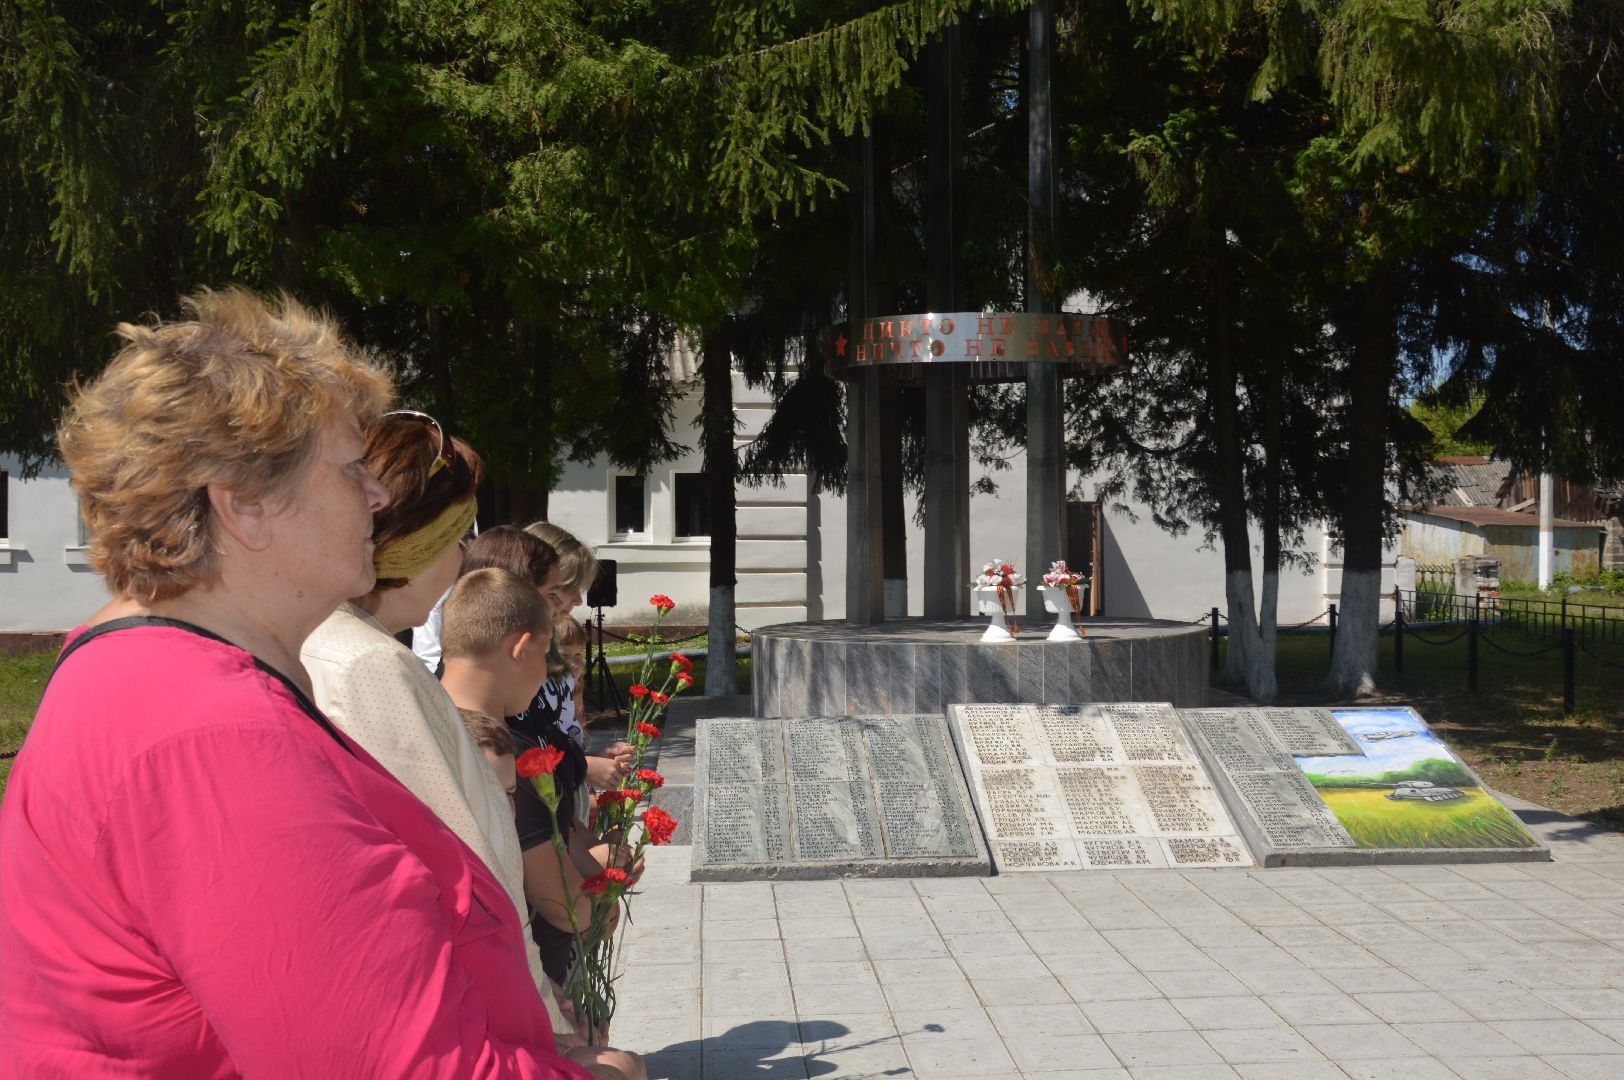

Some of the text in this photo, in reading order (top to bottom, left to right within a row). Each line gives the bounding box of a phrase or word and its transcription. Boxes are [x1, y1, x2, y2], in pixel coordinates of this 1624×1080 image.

[863, 317, 956, 340] НИКТО
[976, 317, 1015, 336] НЕ
[964, 338, 1006, 357] НЕ
